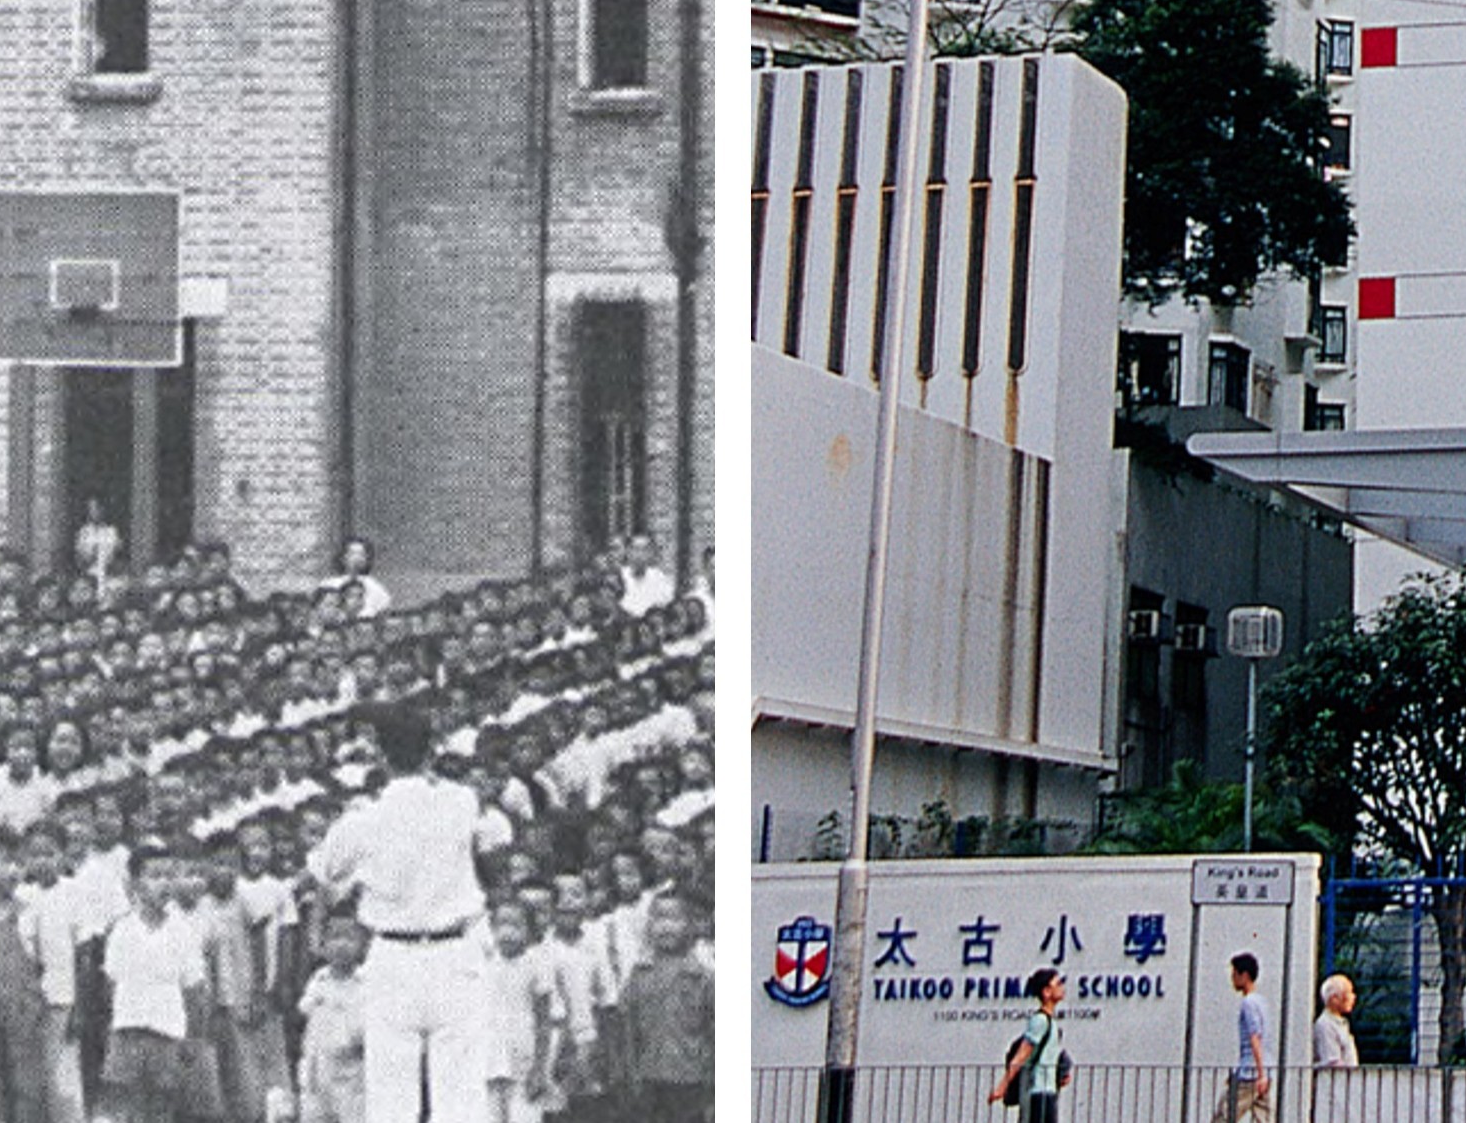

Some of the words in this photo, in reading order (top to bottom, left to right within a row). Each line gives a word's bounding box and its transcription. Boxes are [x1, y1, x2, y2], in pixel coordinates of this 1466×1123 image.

[1208, 866, 1243, 880] King's
[1248, 866, 1280, 879] Road
[873, 913, 1167, 968] 太古小學
[873, 975, 953, 1001] TAIKOO
[1078, 974, 1166, 999] SCHOOL
